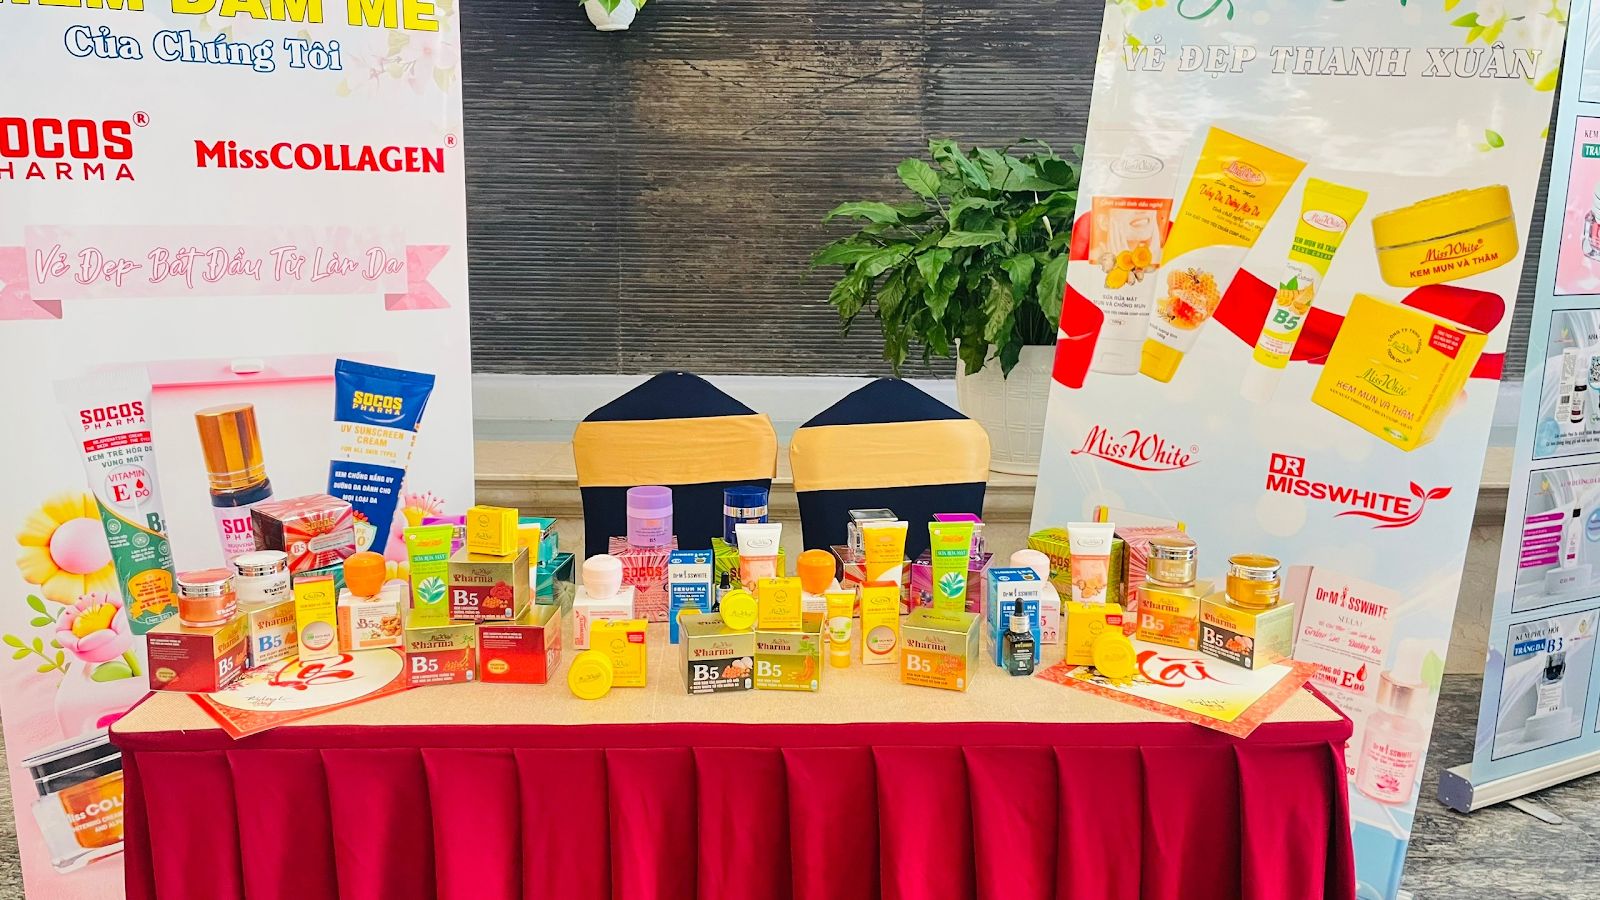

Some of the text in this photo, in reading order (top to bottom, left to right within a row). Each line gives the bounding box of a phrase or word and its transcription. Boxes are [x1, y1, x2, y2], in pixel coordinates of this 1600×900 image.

[64, 24, 343, 73] Của Chúng Tôi
[1123, 34, 1543, 79] VẺ ĐẸP THANH XUÂN
[0, 117, 133, 160] OCOS
[194, 139, 446, 174] MissCOLLAGEN
[0, 161, 135, 181] HARMA
[35, 243, 70, 285] Vẻ
[74, 246, 143, 287] Đẹp
[202, 246, 262, 283] Đầu
[269, 245, 306, 282] Từ
[310, 246, 359, 283] Làn
[361, 246, 405, 282] Da
[1410, 252, 1499, 278] KEM MỤN VÀ THÂM
[1272, 308, 1300, 331] B5
[1336, 380, 1357, 394] KEM
[352, 390, 403, 410] SOCOS
[79, 400, 145, 425] SOCOS
[352, 403, 401, 416] PHARMA
[83, 416, 146, 432] PHARMA
[340, 424, 405, 440] UV SUNSCREEN
[356, 435, 388, 447] CREAM
[87, 452, 105, 463] KEM
[1270, 453, 1305, 477] DR
[108, 469, 146, 482] VITAMIN
[112, 483, 131, 503] E
[1265, 474, 1412, 516] MISSWHITE
[292, 543, 306, 554] B5
[1050, 555, 1070, 569] COS
[453, 573, 494, 584] Pharma
[623, 566, 663, 577] SOCOS
[453, 589, 479, 606] B5
[1142, 599, 1180, 613] Pharma
[257, 614, 294, 630] Pharma
[1040, 615, 1047, 626] 5
[1141, 613, 1165, 632] B5
[1204, 611, 1237, 630] Pharma
[258, 635, 282, 653] B5
[411, 640, 454, 650] Pharma
[1202, 626, 1224, 647] B5
[693, 648, 734, 657] Pharma
[757, 642, 791, 651] Pharma
[906, 639, 947, 652] Pharma
[218, 655, 234, 677] B5
[411, 656, 439, 674] B5
[757, 661, 782, 677] B5
[906, 653, 931, 673] B5
[693, 664, 720, 681] B5
[1340, 670, 1355, 689] E
